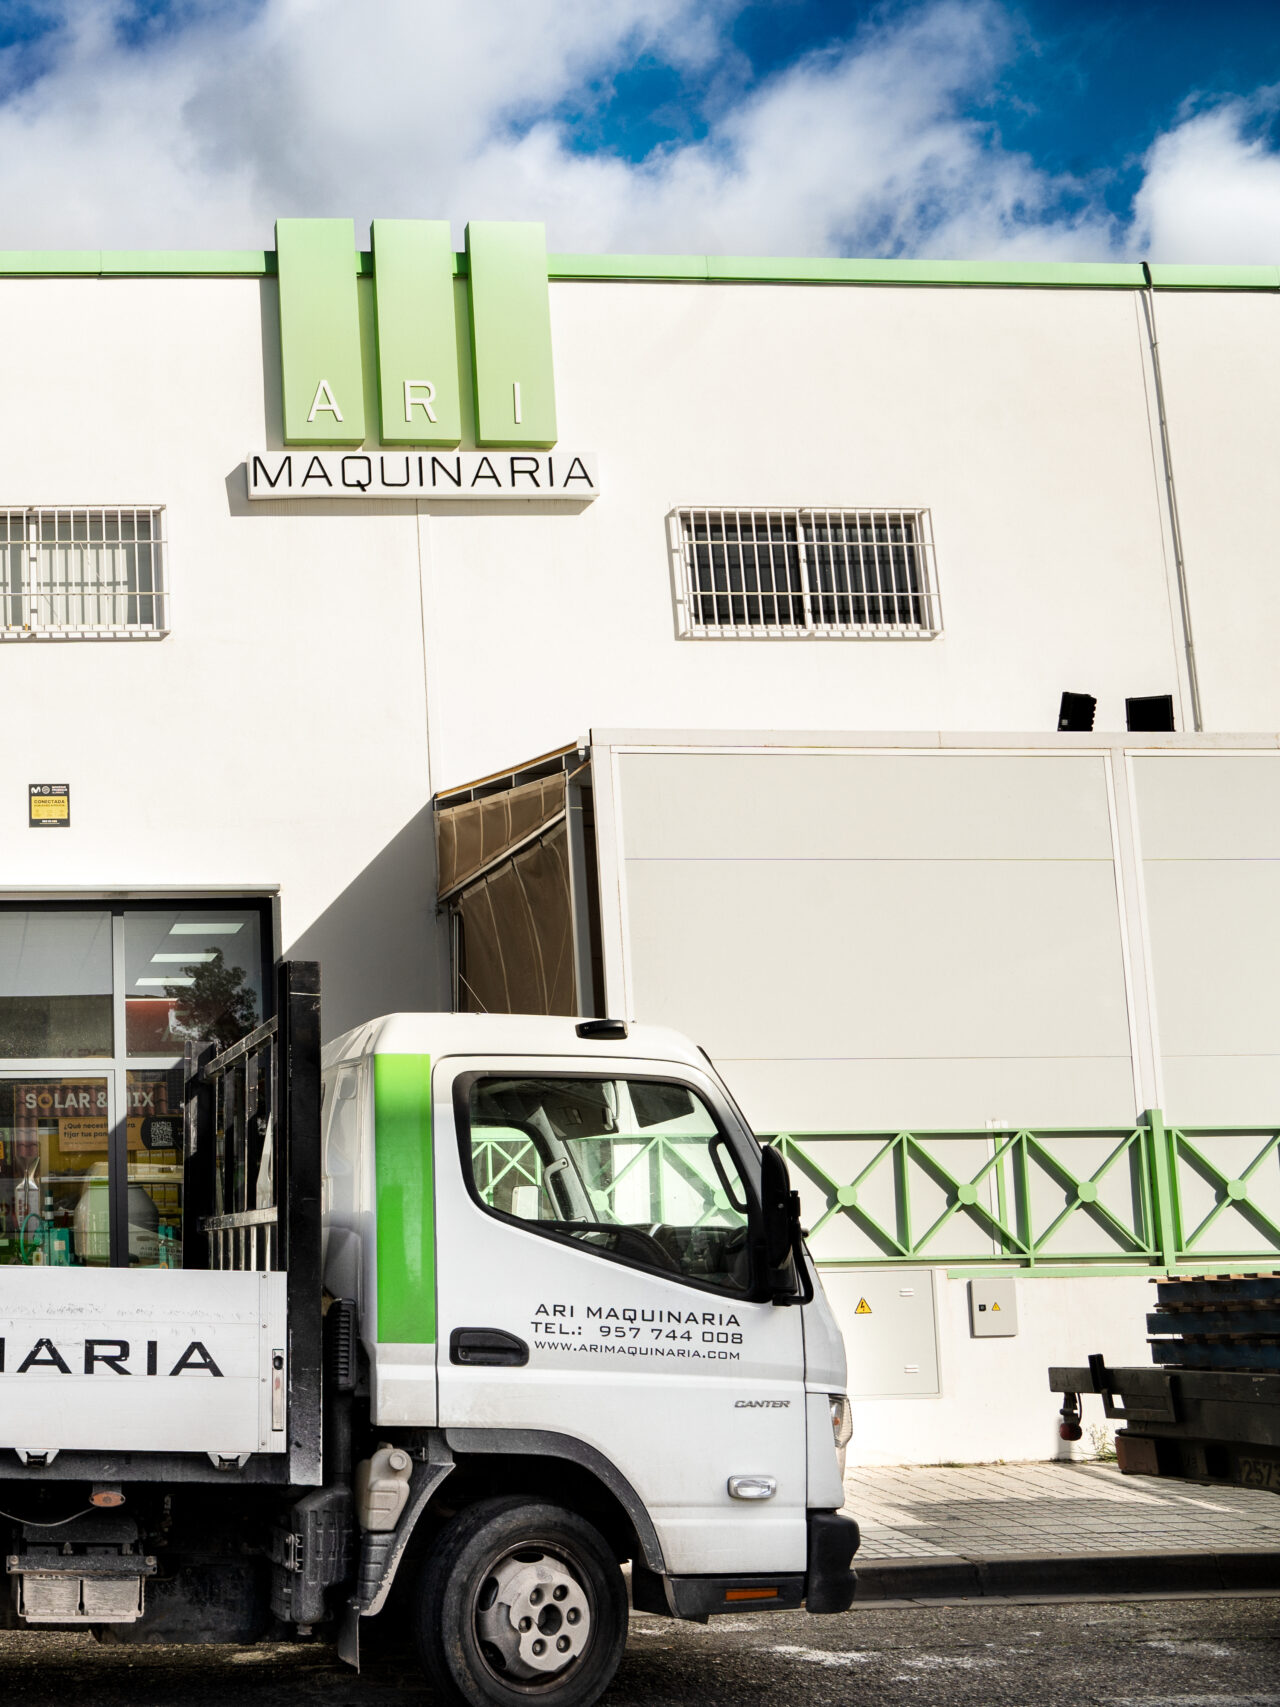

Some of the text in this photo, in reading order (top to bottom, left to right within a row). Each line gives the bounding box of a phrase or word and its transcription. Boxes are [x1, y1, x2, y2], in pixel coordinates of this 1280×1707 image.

[252, 455, 594, 492] MAQUINARIA
[25, 1092, 91, 1109] SOLAR
[535, 1303, 741, 1327] ARI MAQUINARIA
[531, 1321, 744, 1345] TEL.: 957 744 008
[534, 1340, 741, 1361] WWW.ARIMAQUINARIA.COM
[734, 1400, 791, 1409] CANTER
